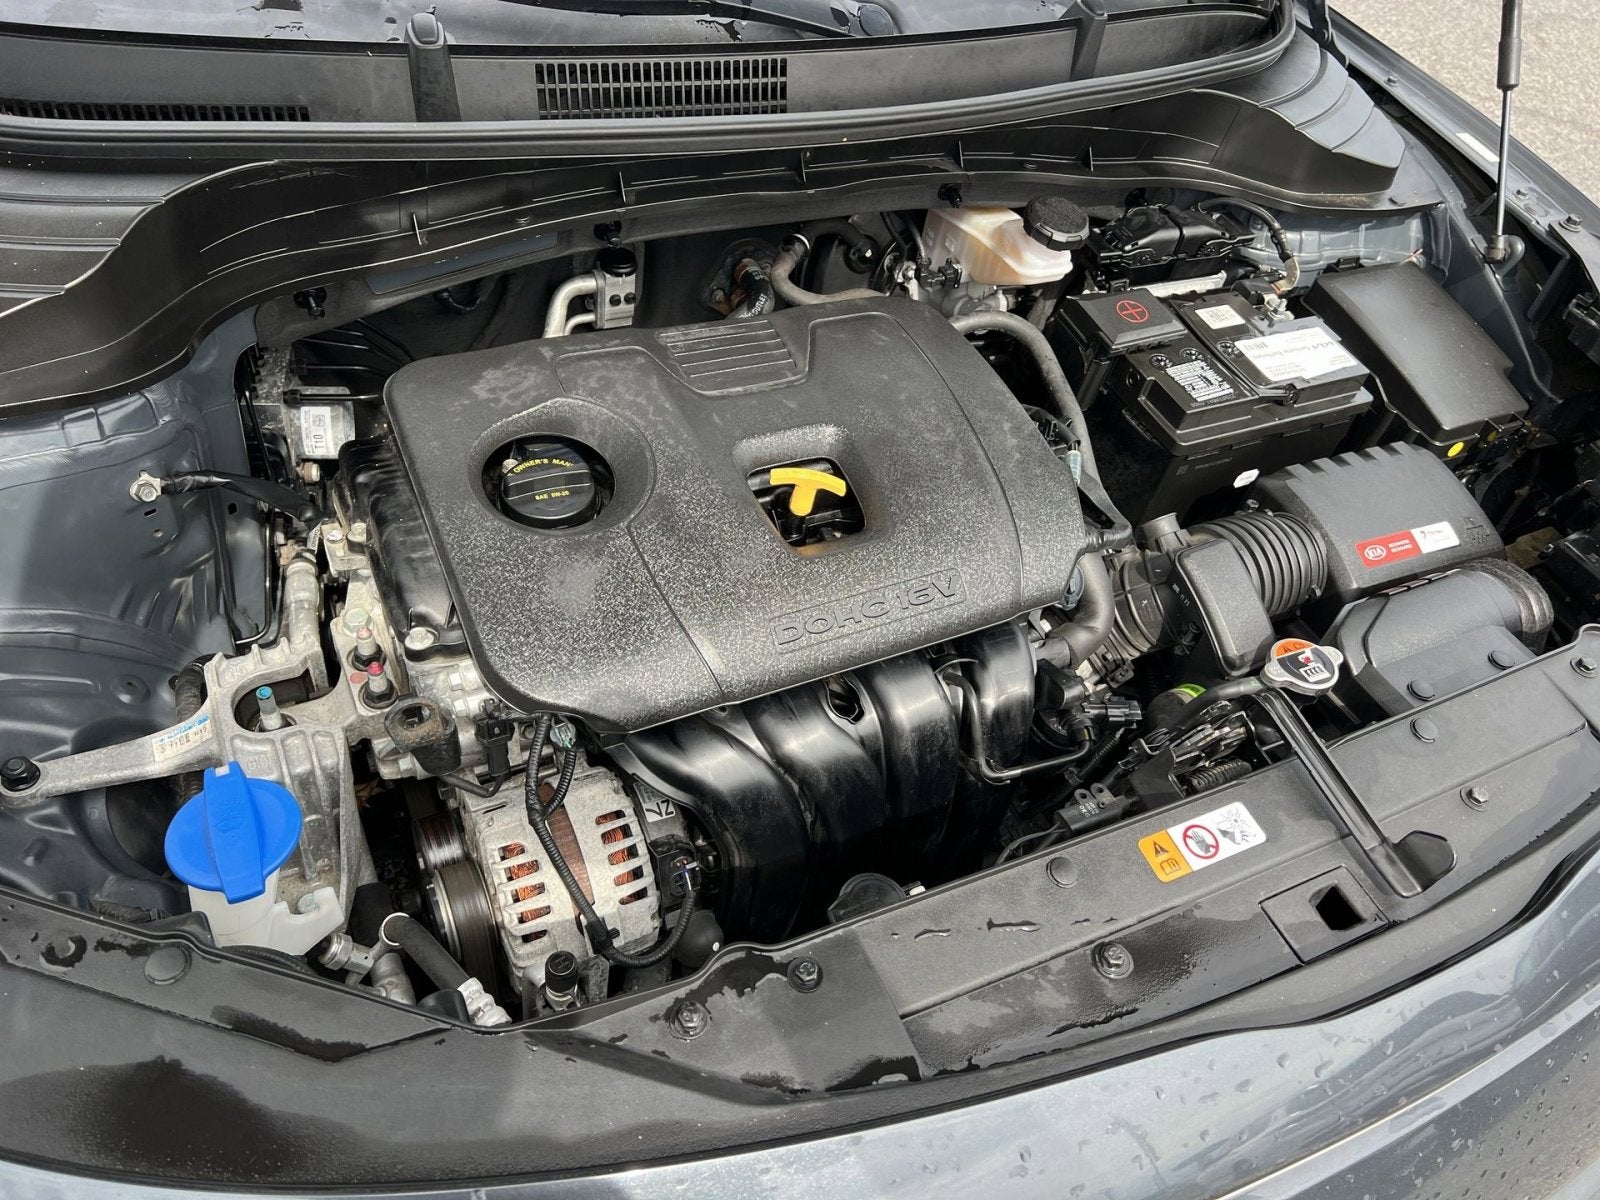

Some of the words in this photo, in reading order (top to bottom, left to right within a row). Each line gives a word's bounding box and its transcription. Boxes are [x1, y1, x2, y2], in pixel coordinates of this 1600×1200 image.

[513, 458, 549, 473] OWNER'S
[1365, 546, 1385, 559] KIA
[773, 601, 890, 646] DOHC
[896, 574, 961, 611] 16V
